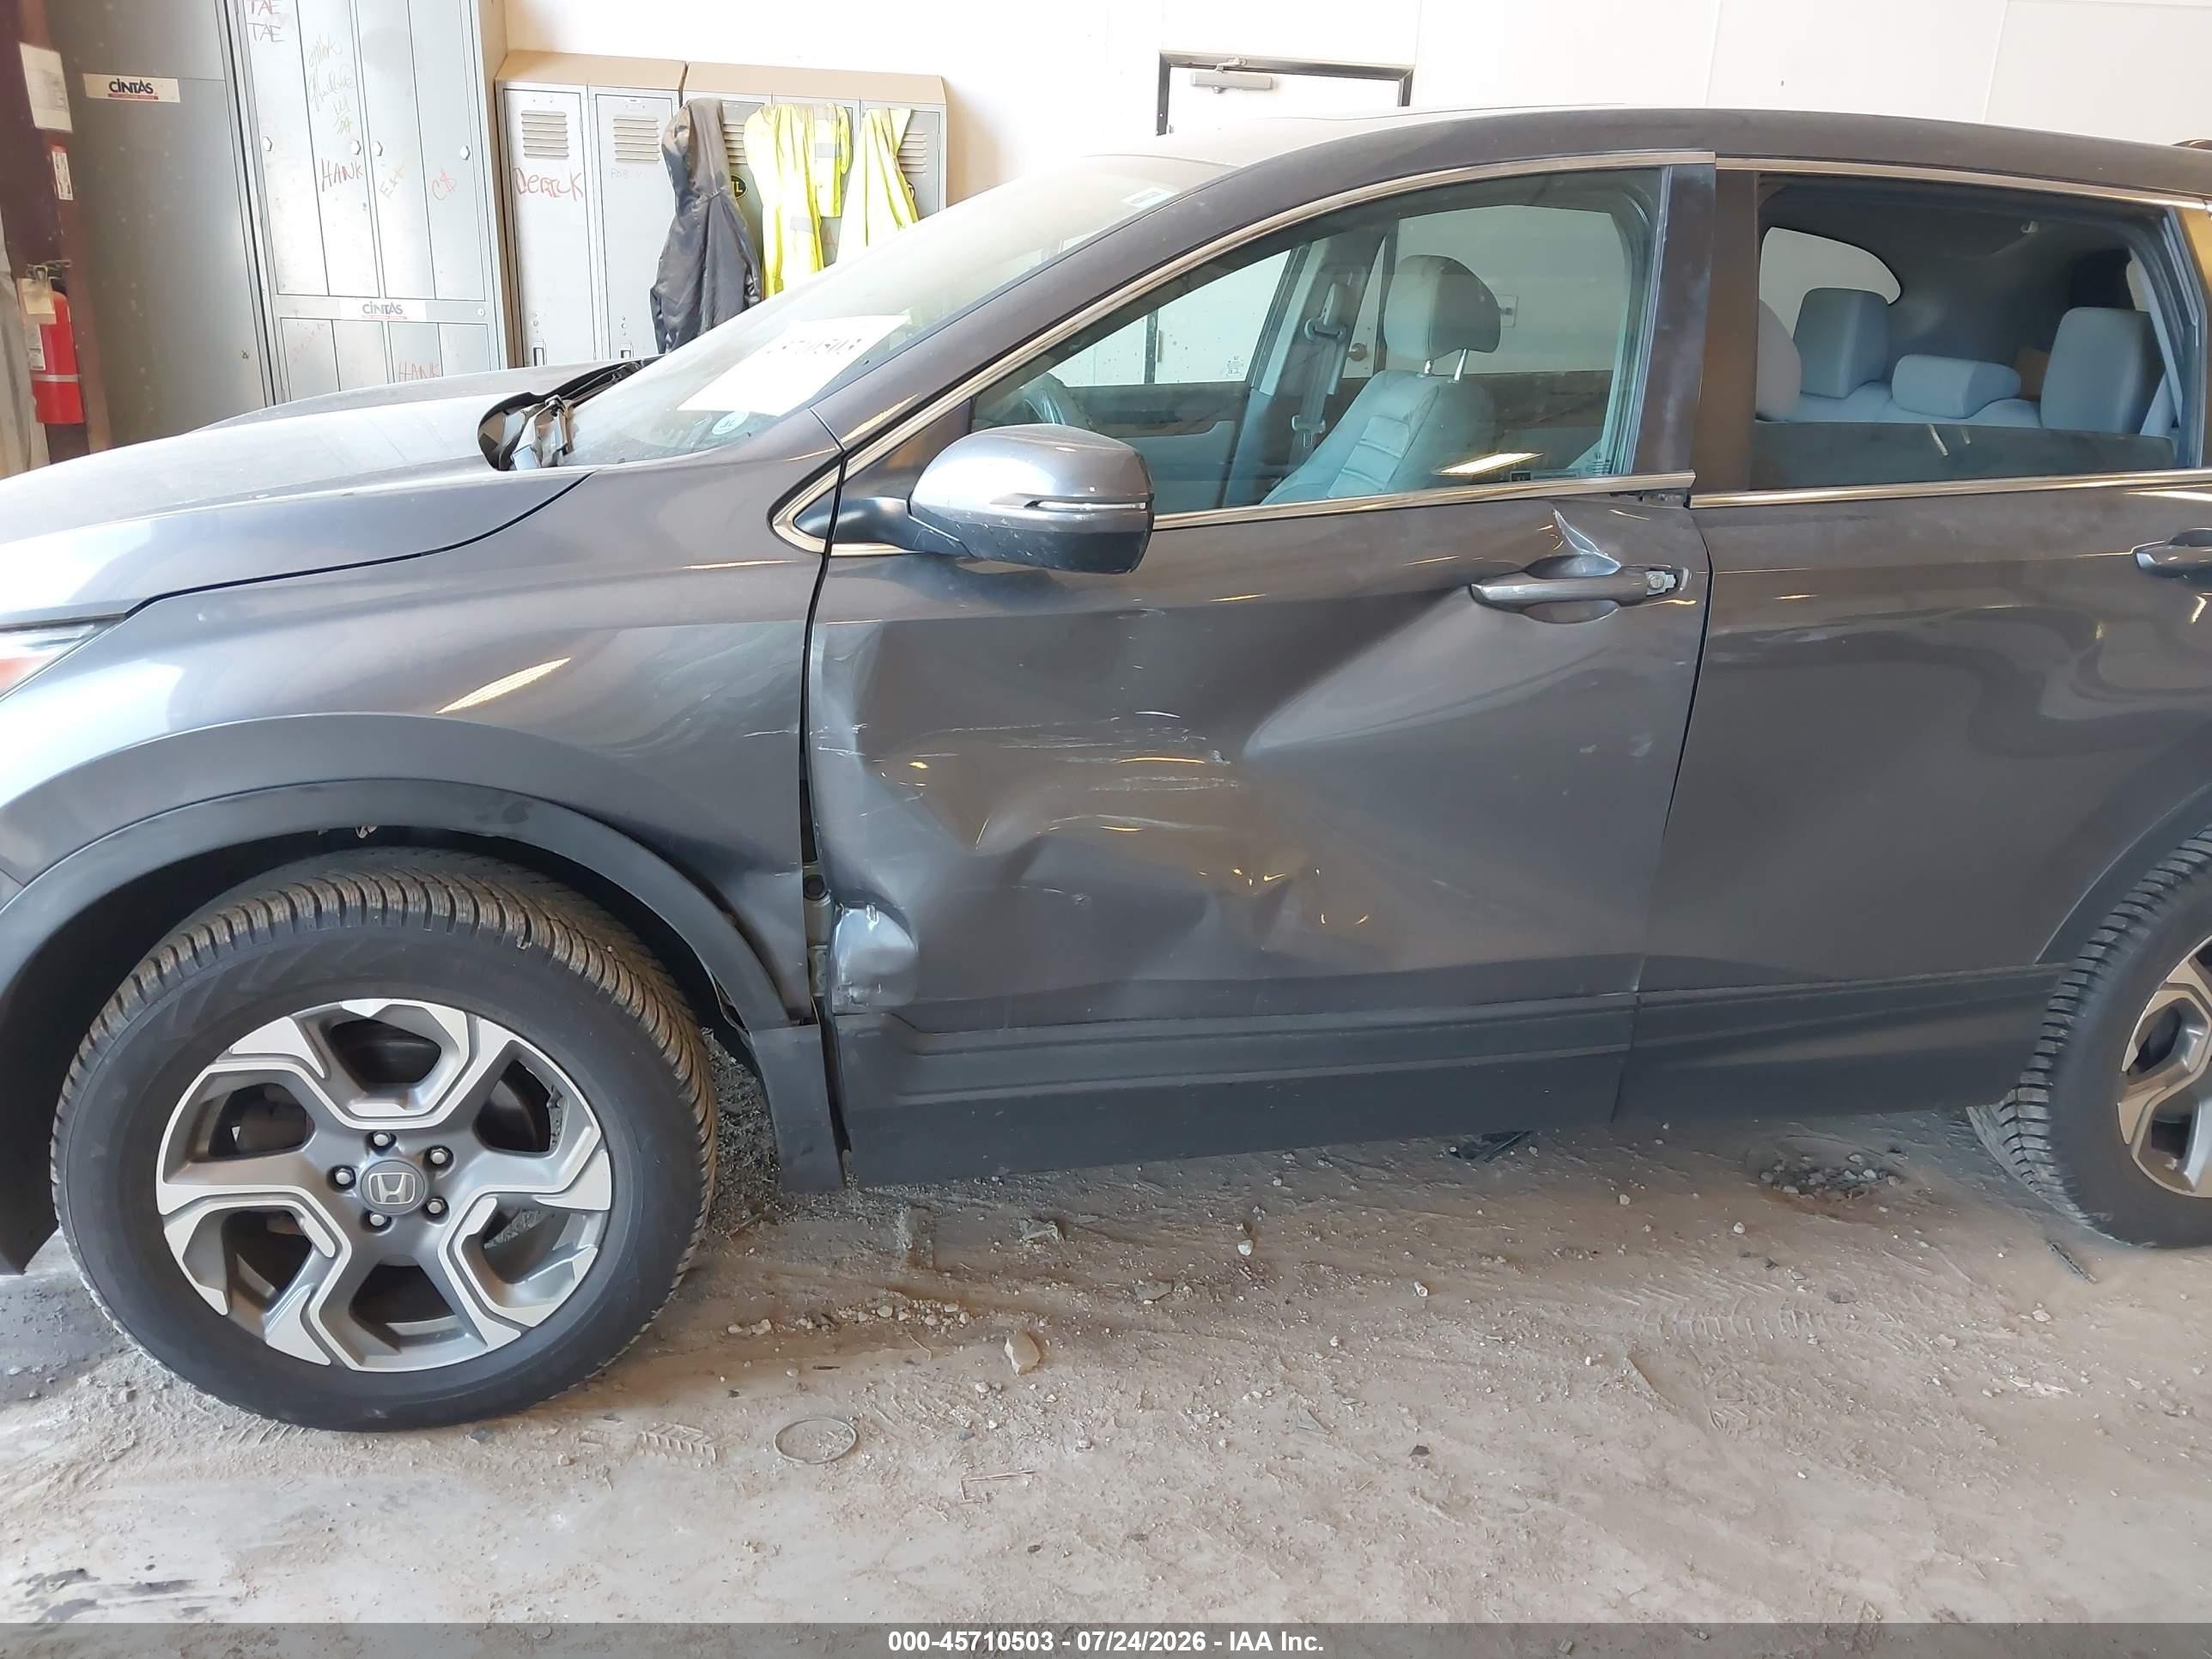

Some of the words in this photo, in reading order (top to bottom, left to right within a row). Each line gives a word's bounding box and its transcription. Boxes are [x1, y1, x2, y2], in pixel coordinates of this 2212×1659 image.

[247, 22, 285, 42] TAE
[320, 158, 364, 192] HANK
[398, 361, 441, 382] HANK
